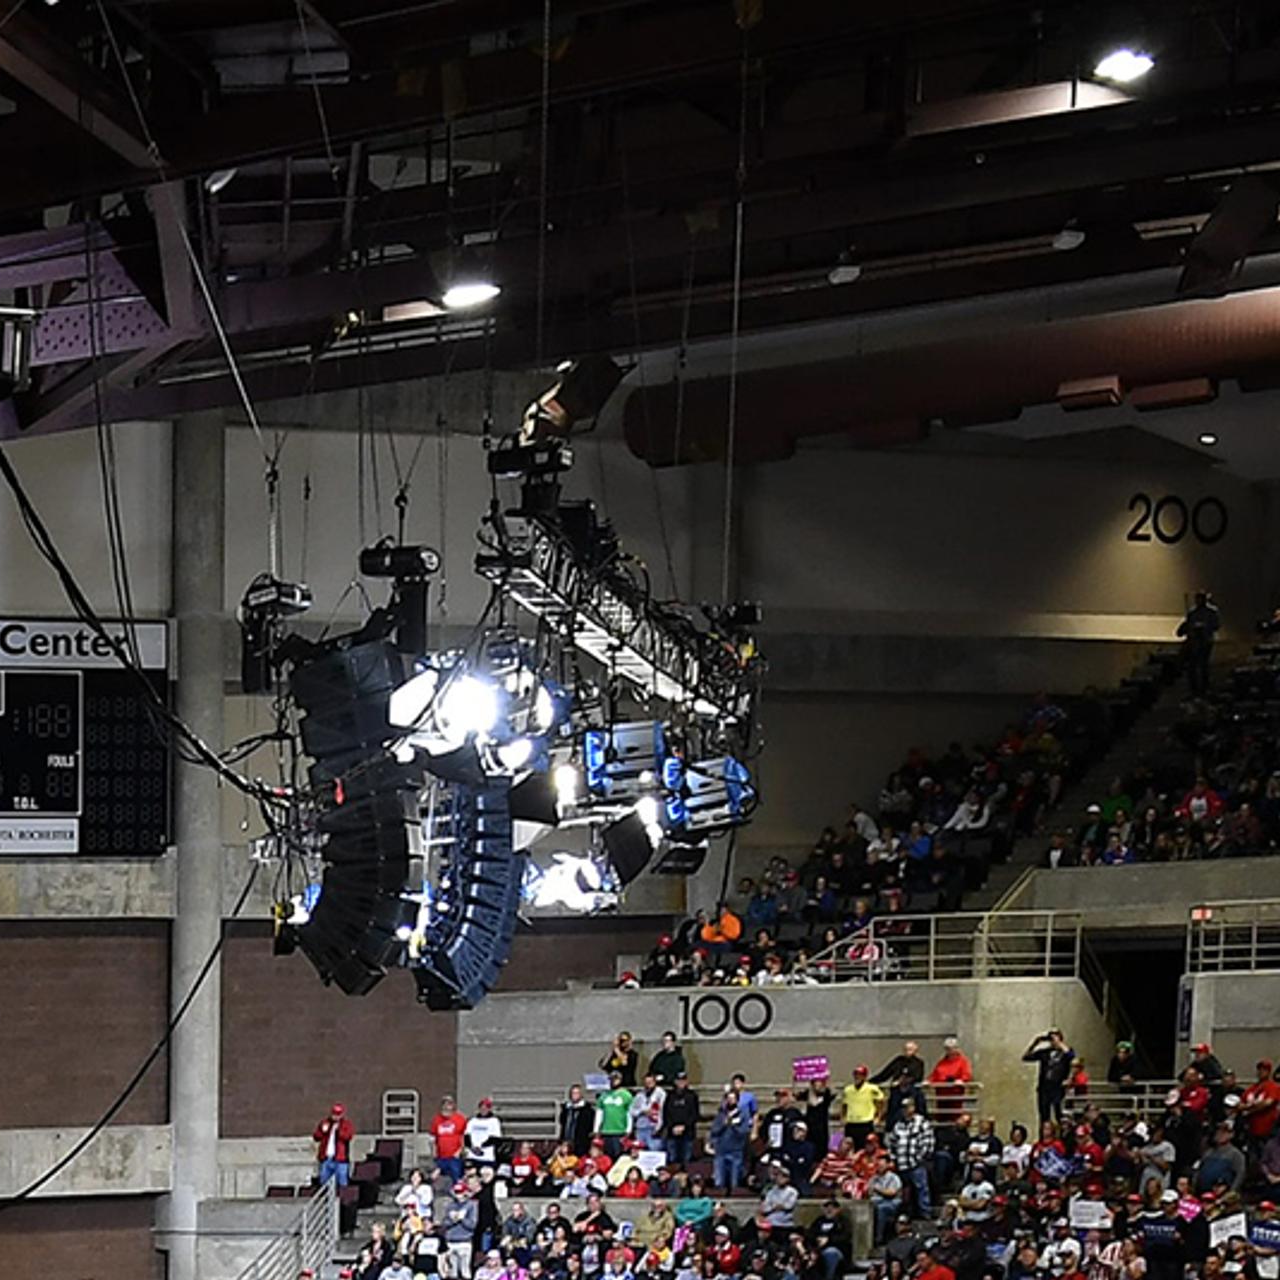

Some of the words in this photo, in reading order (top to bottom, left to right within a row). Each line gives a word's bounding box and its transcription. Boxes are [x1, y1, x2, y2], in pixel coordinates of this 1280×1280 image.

[1127, 493, 1228, 544] 200
[0, 624, 130, 658] Center
[47, 755, 75, 767] FOULS
[679, 993, 773, 1036] 100
